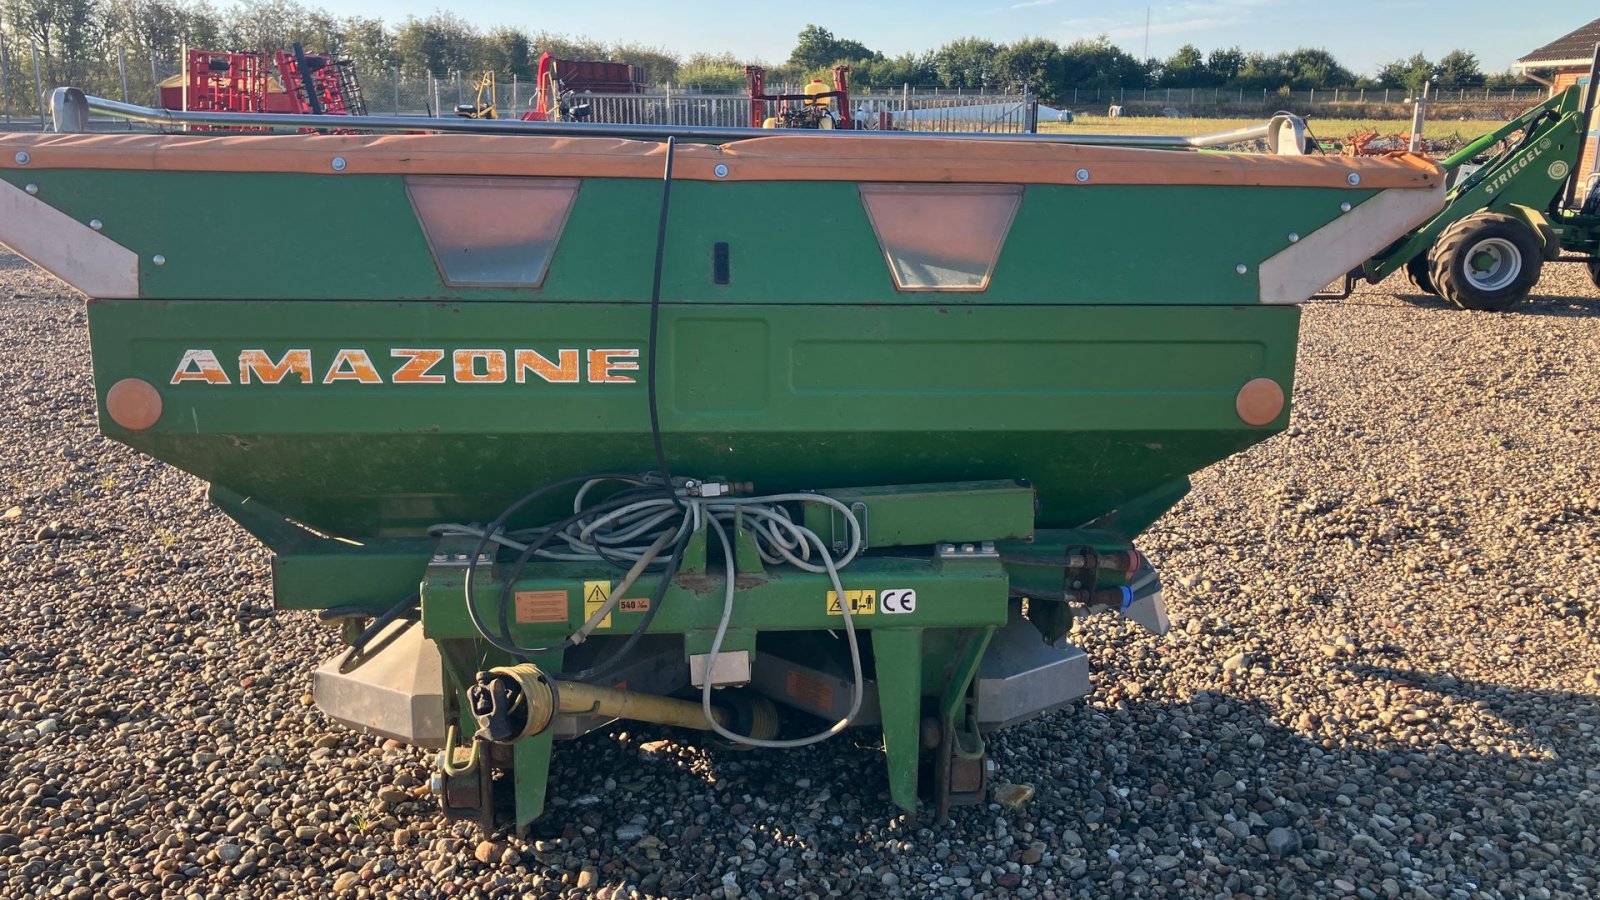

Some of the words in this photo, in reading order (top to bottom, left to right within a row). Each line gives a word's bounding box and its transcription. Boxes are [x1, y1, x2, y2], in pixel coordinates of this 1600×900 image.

[1485, 146, 1542, 194] STRIEGEL
[169, 348, 640, 385] AMAZONE
[620, 601, 636, 609] 540
[883, 591, 912, 612] CE
